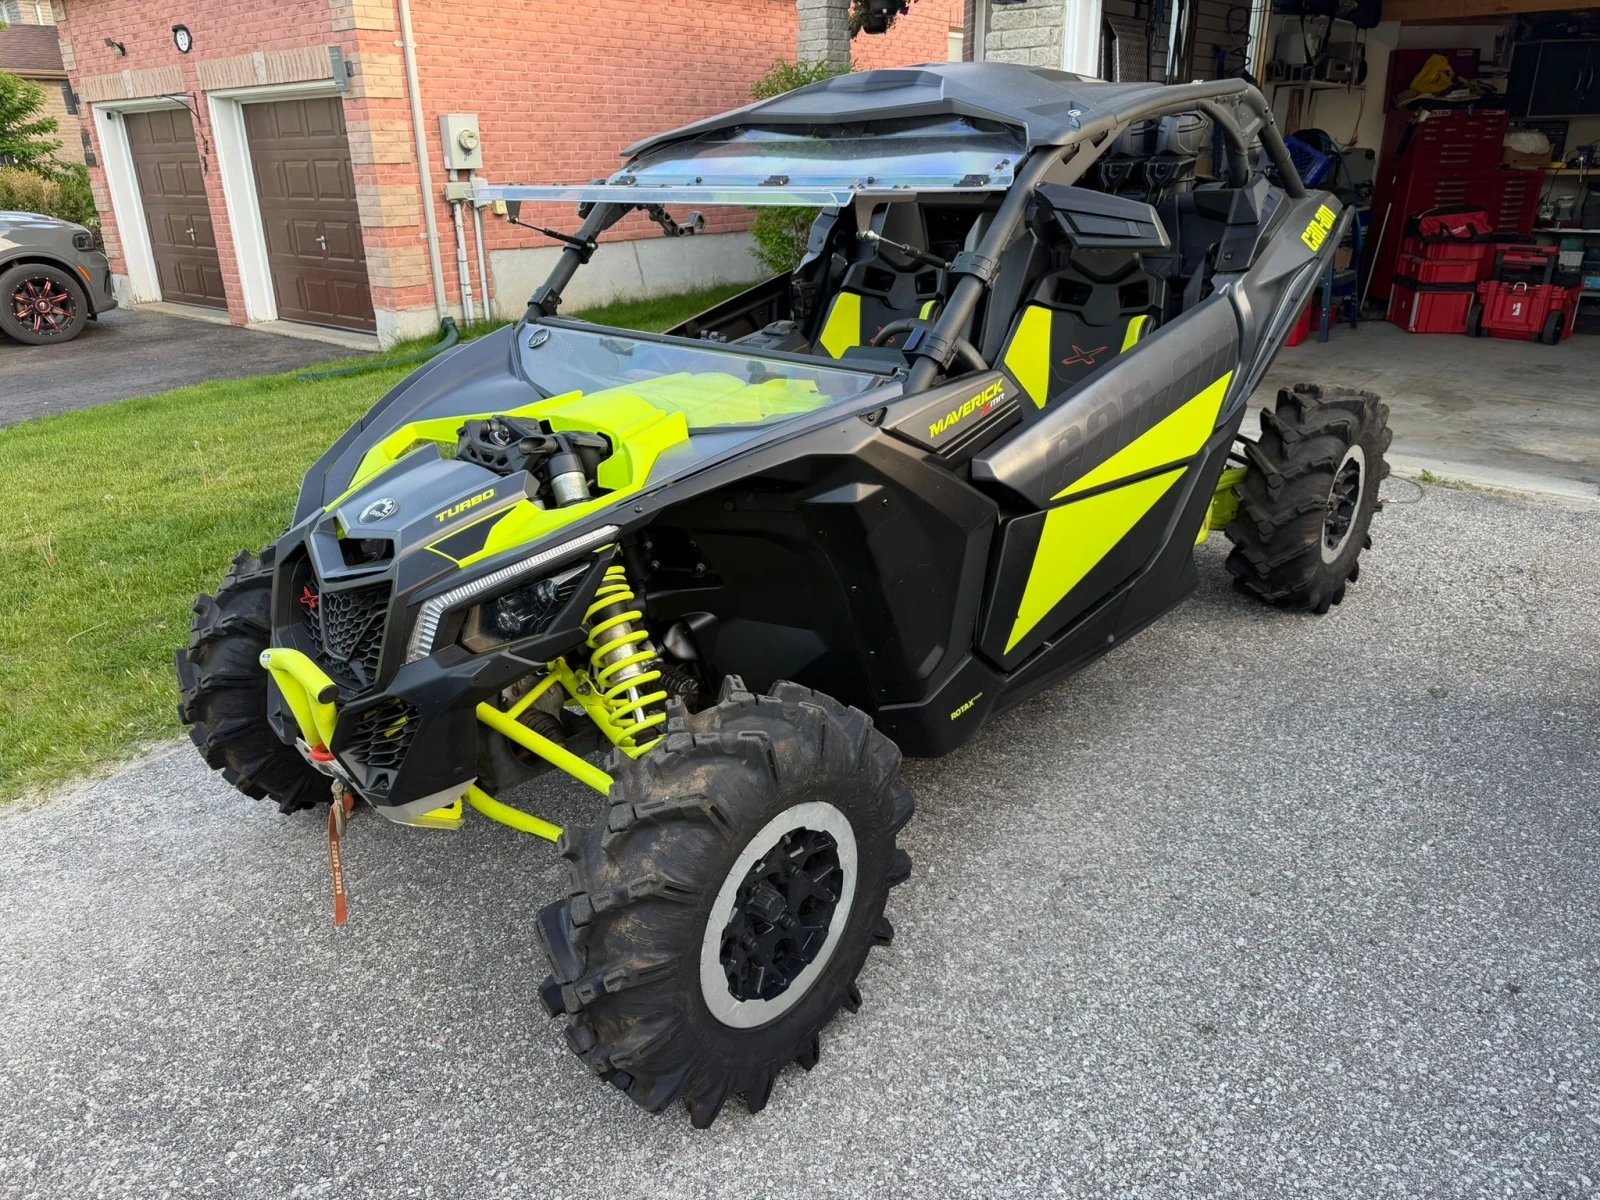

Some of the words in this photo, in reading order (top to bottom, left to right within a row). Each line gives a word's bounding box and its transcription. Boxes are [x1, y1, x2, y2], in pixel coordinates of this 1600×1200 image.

[1301, 204, 1336, 252] can-am
[929, 378, 1004, 439] MAVERICK
[369, 509, 385, 518] BRP
[435, 488, 496, 522] TURBO
[951, 700, 975, 720] ROTAX
[331, 841, 342, 894] can-am
